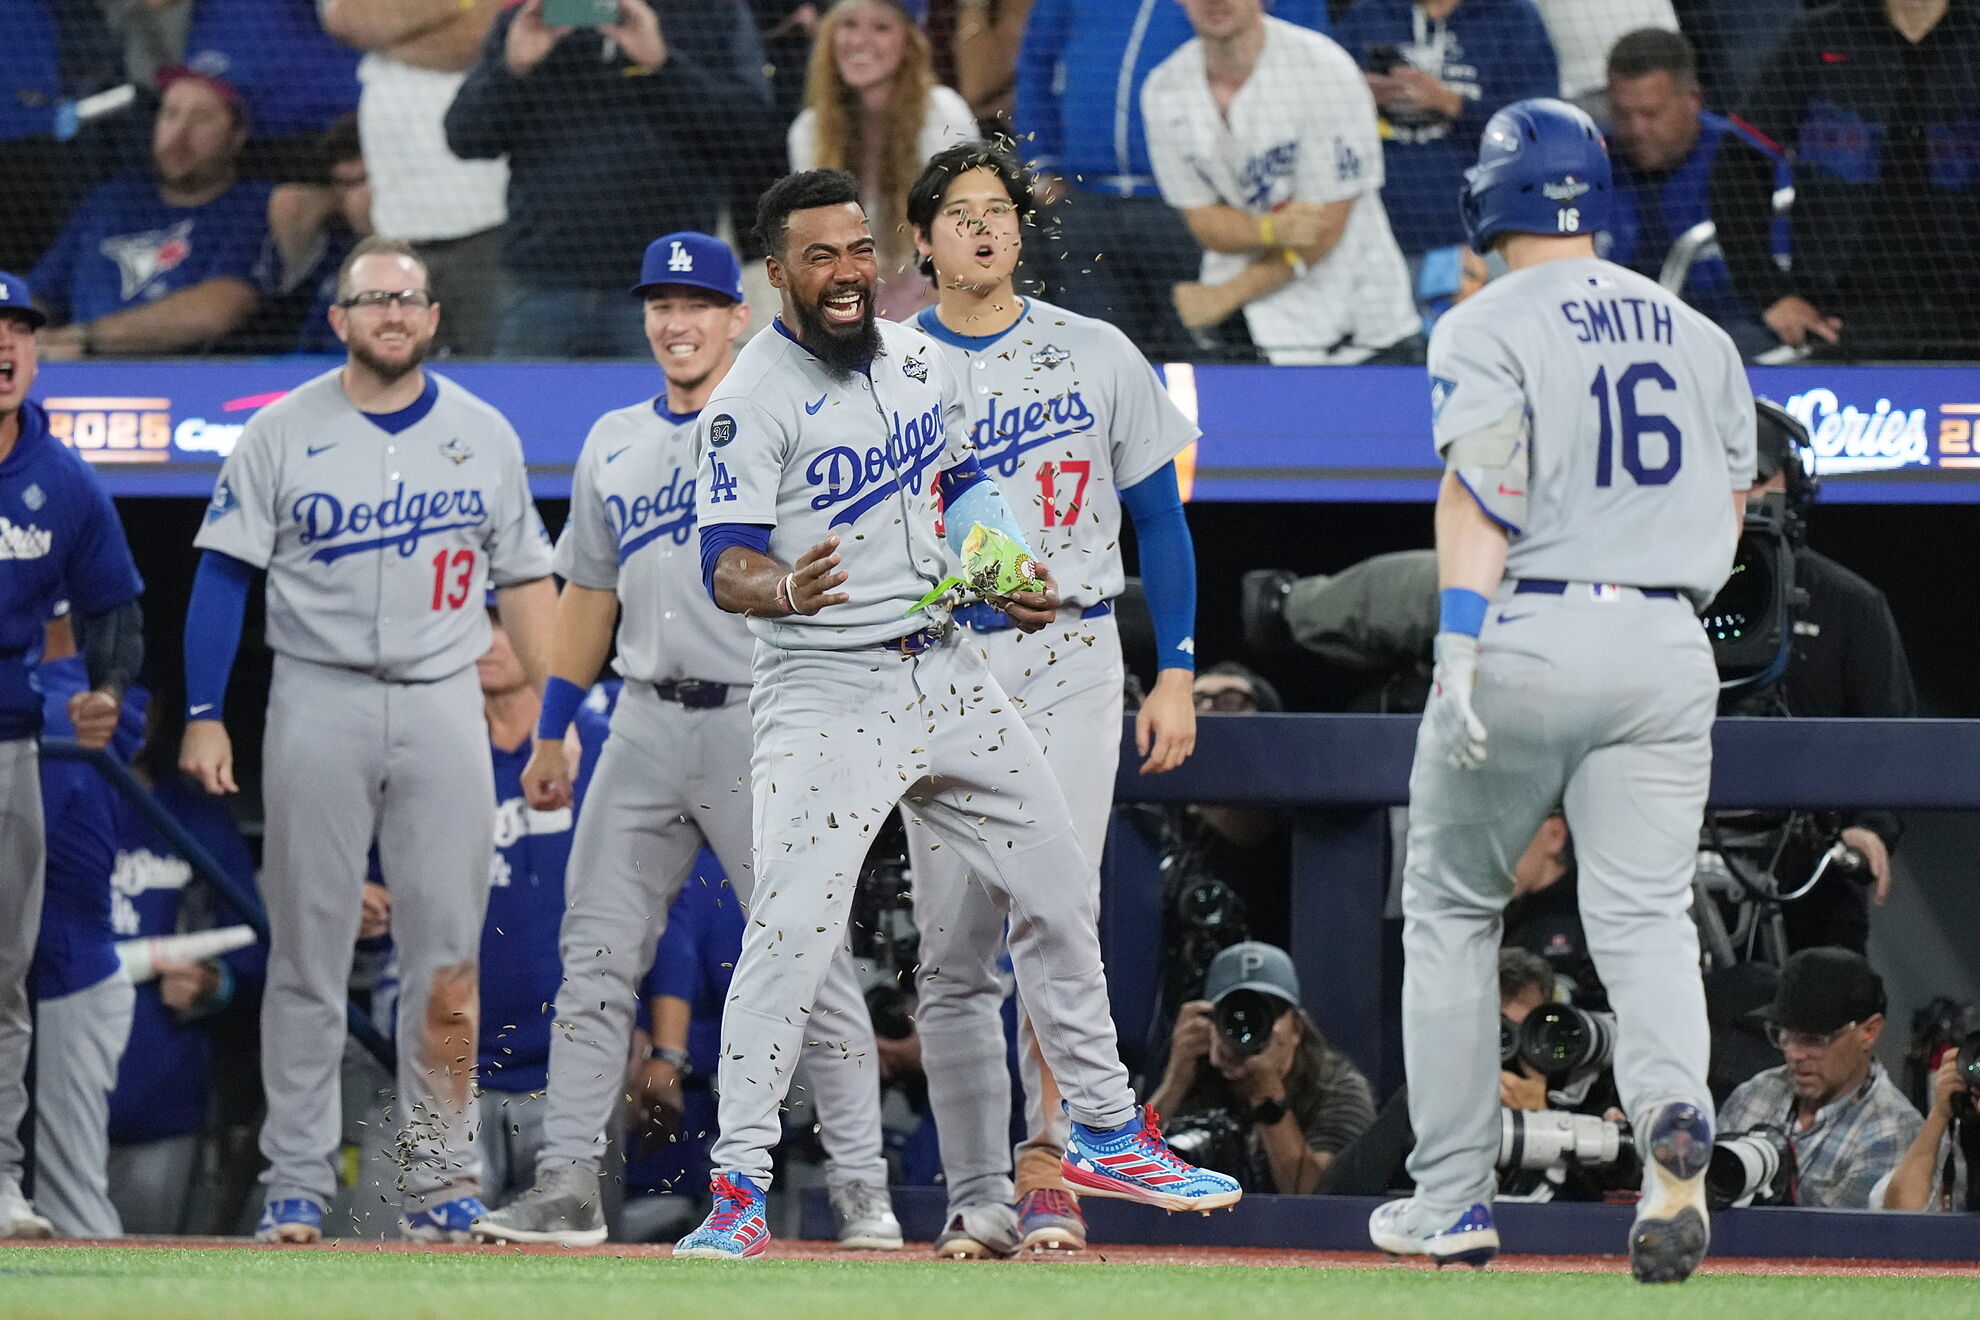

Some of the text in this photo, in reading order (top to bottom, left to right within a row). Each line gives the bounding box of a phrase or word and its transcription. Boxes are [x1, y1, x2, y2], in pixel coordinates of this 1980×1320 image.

[1557, 208, 1580, 232] 16
[667, 241, 693, 272] LA
[1562, 298, 1674, 346] SMITH
[50, 412, 171, 449] 2025
[712, 425, 730, 442] 34
[970, 391, 1095, 478] dgers
[1591, 362, 1683, 488] 16
[708, 451, 737, 504] LA
[806, 402, 944, 511] Dodger
[293, 481, 488, 560] Dodgers
[604, 468, 698, 546] Dodg
[1036, 461, 1091, 527] 17
[431, 549, 476, 612] 13
[1241, 951, 1265, 979] P
